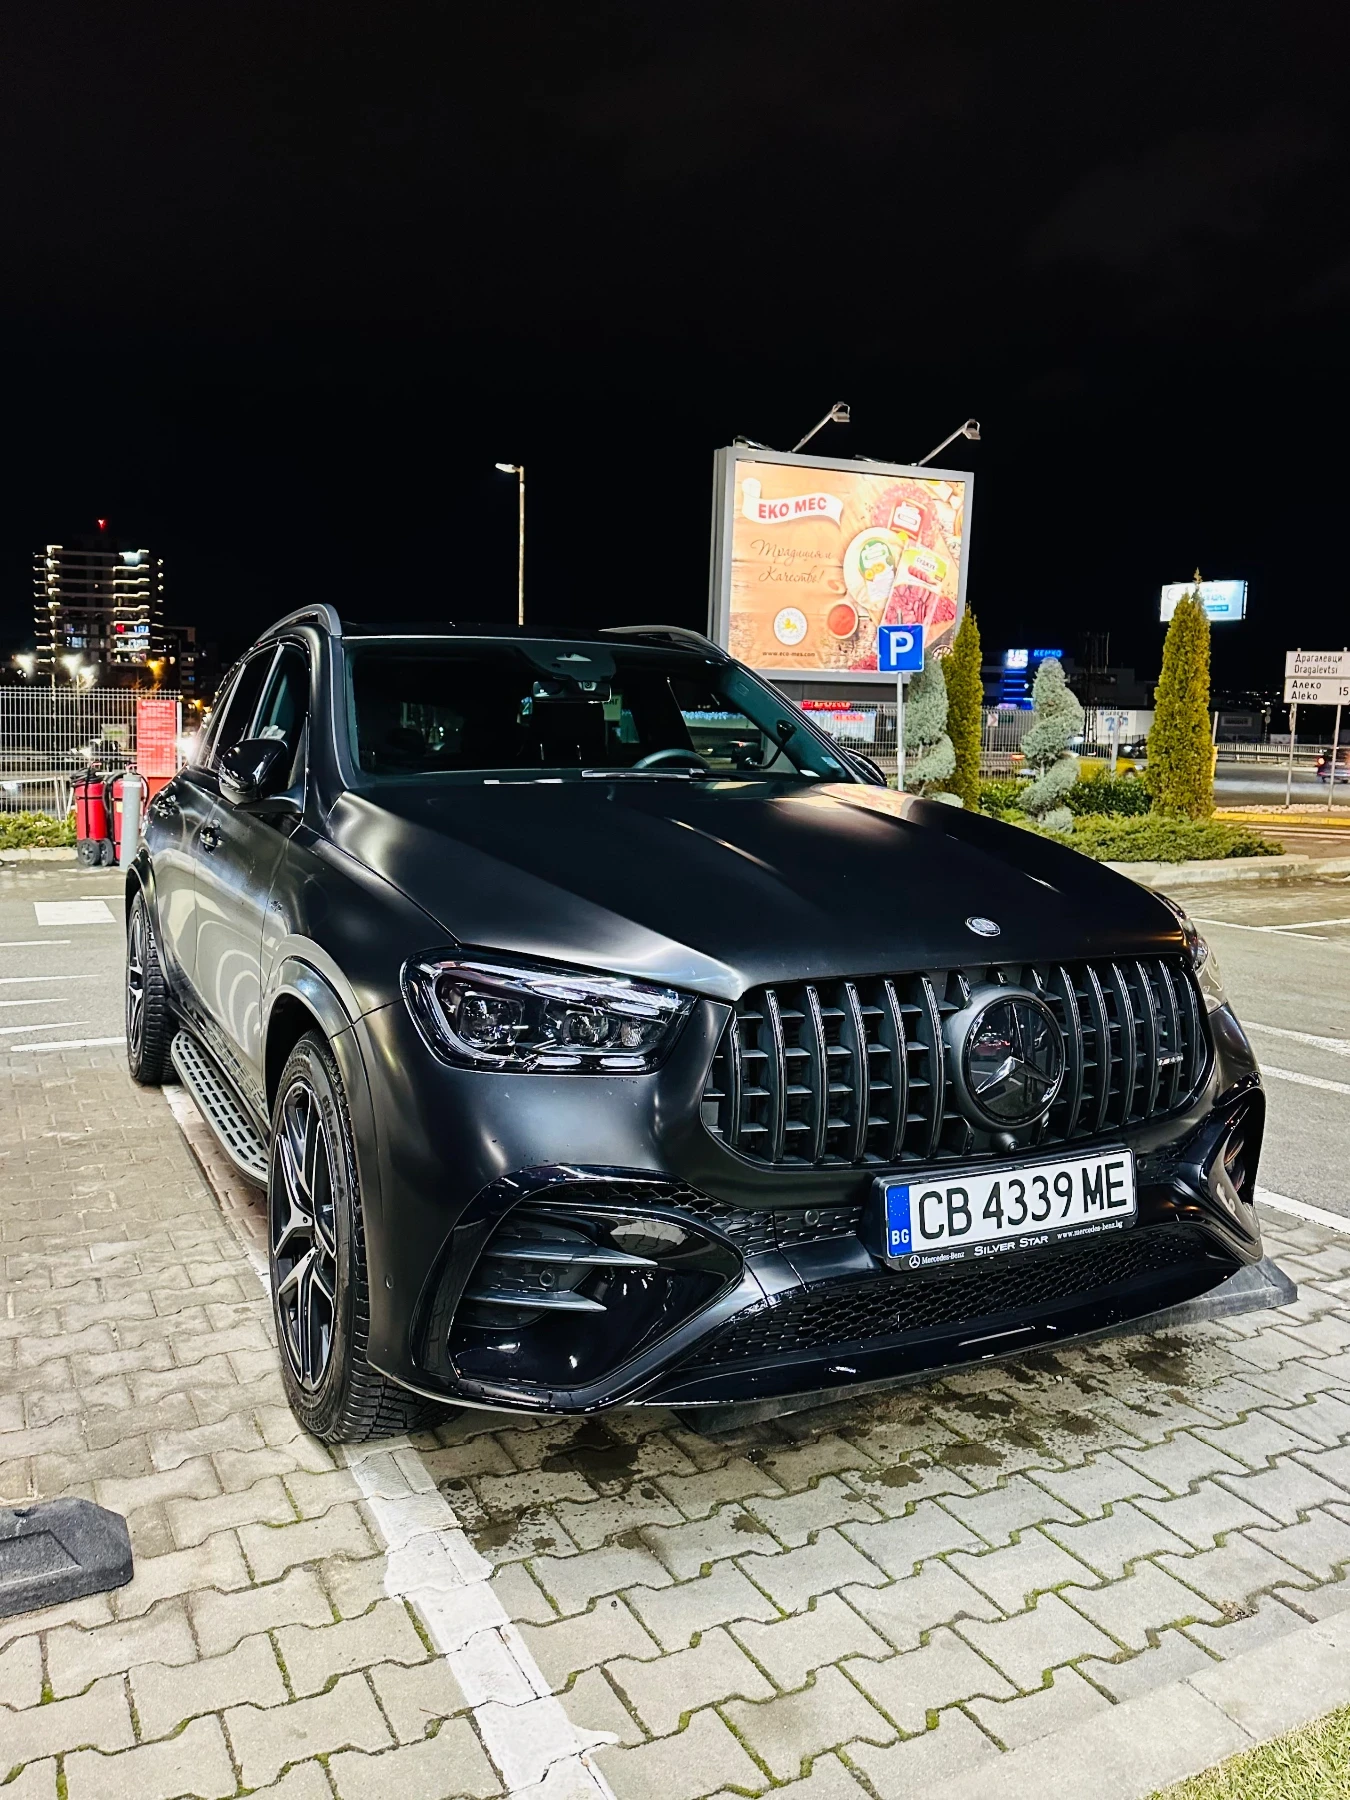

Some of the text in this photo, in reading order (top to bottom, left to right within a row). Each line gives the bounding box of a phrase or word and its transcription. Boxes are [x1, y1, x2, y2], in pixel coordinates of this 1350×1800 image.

[758, 497, 827, 519] ЕКО МЕС
[890, 631, 914, 666] P
[1295, 653, 1343, 665] Драгалевци
[1294, 664, 1338, 677] Dragalevtsi
[1291, 680, 1322, 690] Алеко
[1339, 686, 1349, 696] 15
[1291, 690, 1318, 701] Aleko
[918, 1160, 1127, 1240] CB 4339 ME
[891, 1229, 910, 1246] BG
[921, 1220, 1124, 1265] Mercedes-Benz SILVER STAR www.mercedes-benz.bg
